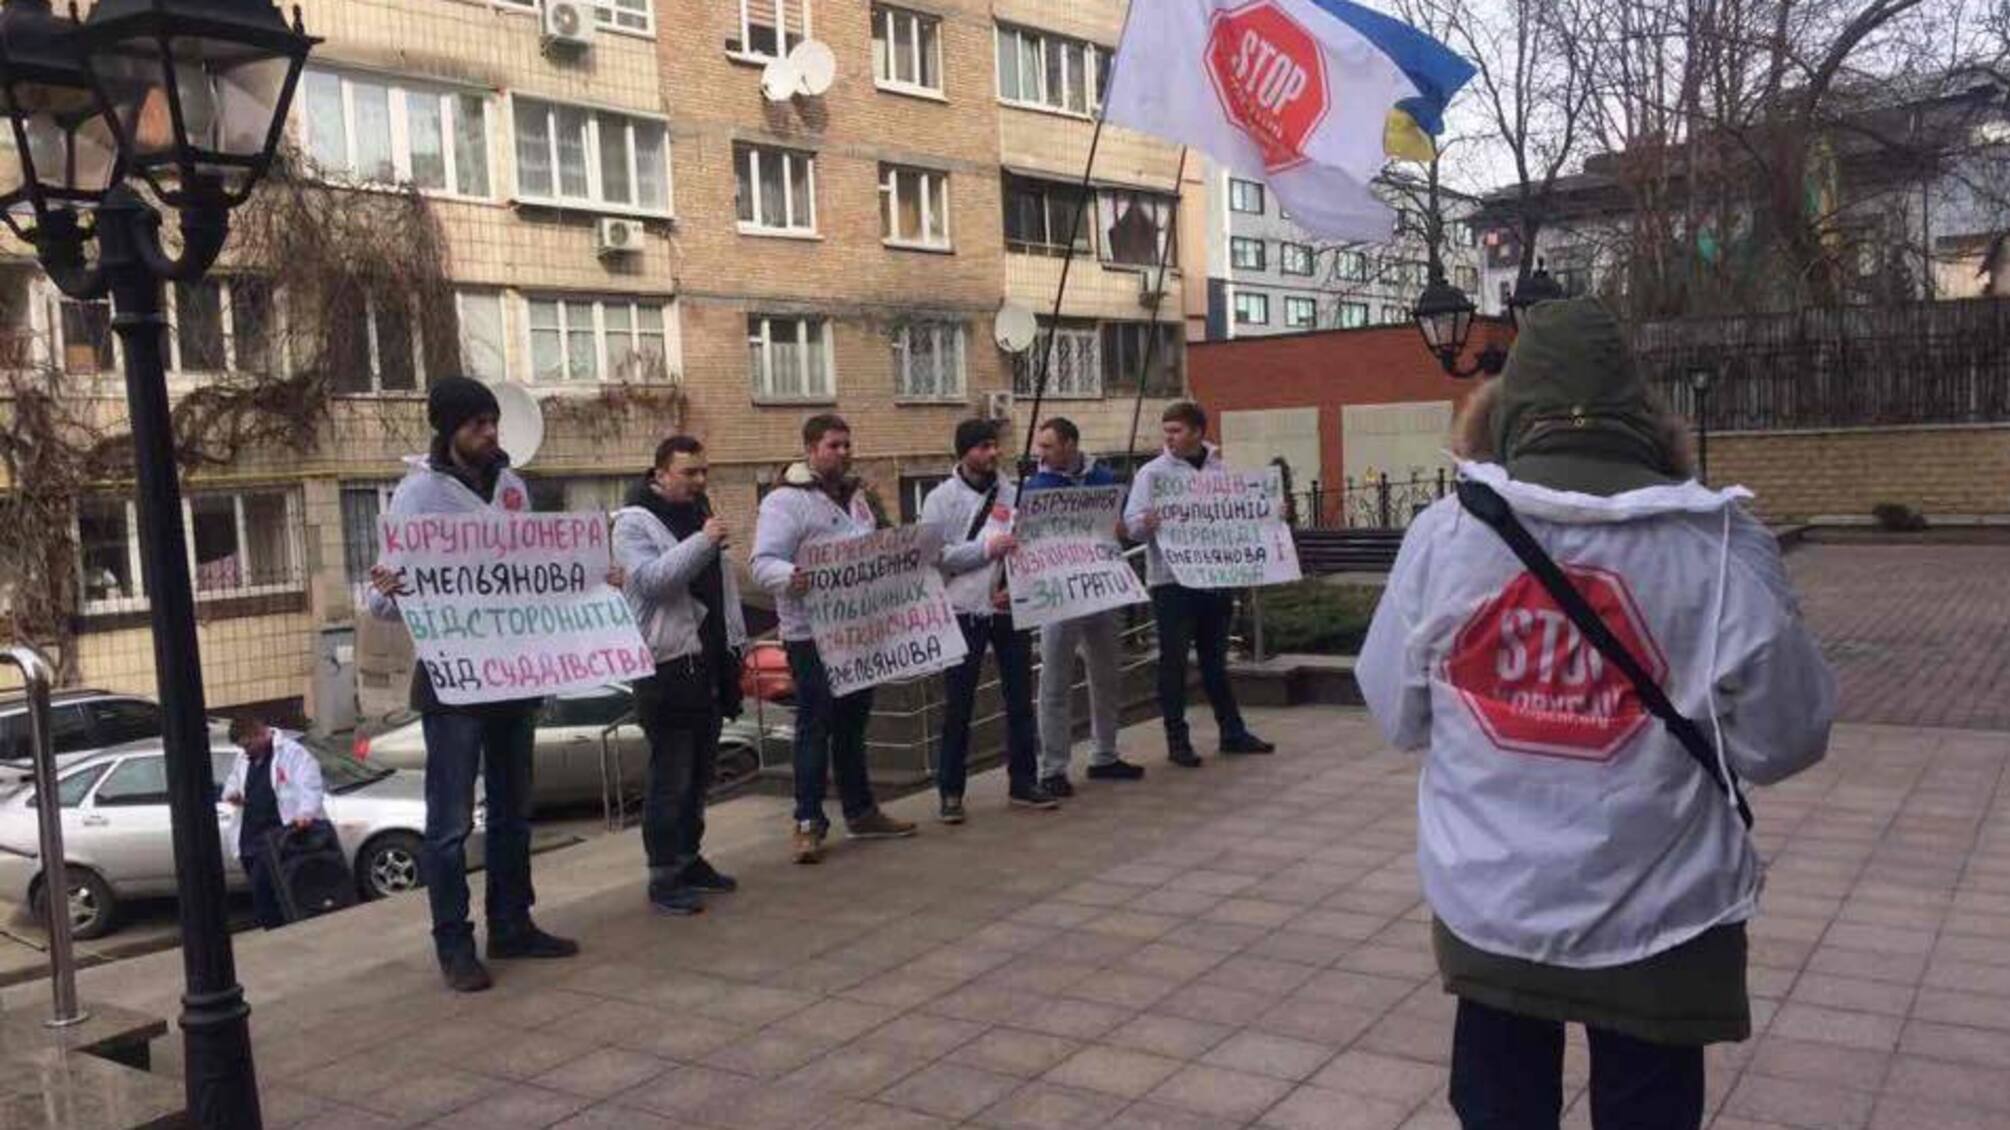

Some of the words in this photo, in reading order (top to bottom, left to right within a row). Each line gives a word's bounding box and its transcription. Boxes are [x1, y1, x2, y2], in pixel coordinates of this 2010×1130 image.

[1231, 29, 1306, 116] STOP
[384, 517, 606, 556] КОРУПЦІОНЕРА
[394, 562, 586, 598] ЄМЕЛЬЯНОВА
[1031, 577, 1065, 609] ЗА
[405, 598, 632, 640] ВІДСТОРОНИТИ
[426, 651, 482, 691] ВІД
[482, 648, 656, 688] СУДДІВСТВА
